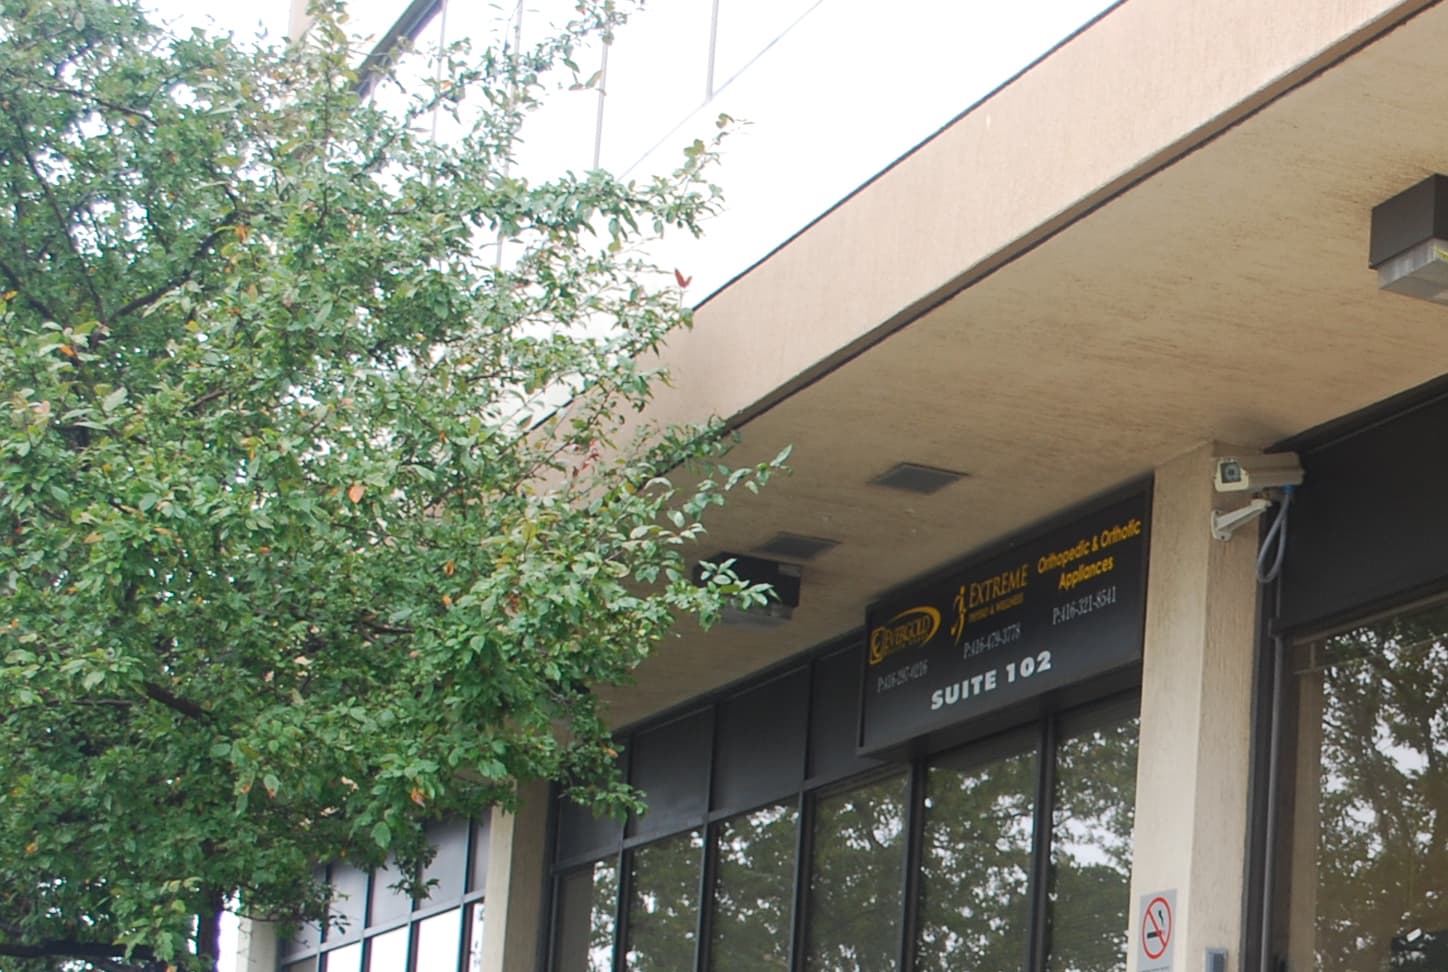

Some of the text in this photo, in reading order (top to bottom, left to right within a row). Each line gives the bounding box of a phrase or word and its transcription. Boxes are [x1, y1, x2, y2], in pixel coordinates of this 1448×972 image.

[1038, 518, 1142, 574] Orthopedic & Orthotic
[969, 563, 1029, 609] EXTREME
[1058, 556, 1114, 590] Appliances
[931, 651, 1052, 711] SUITE 102
